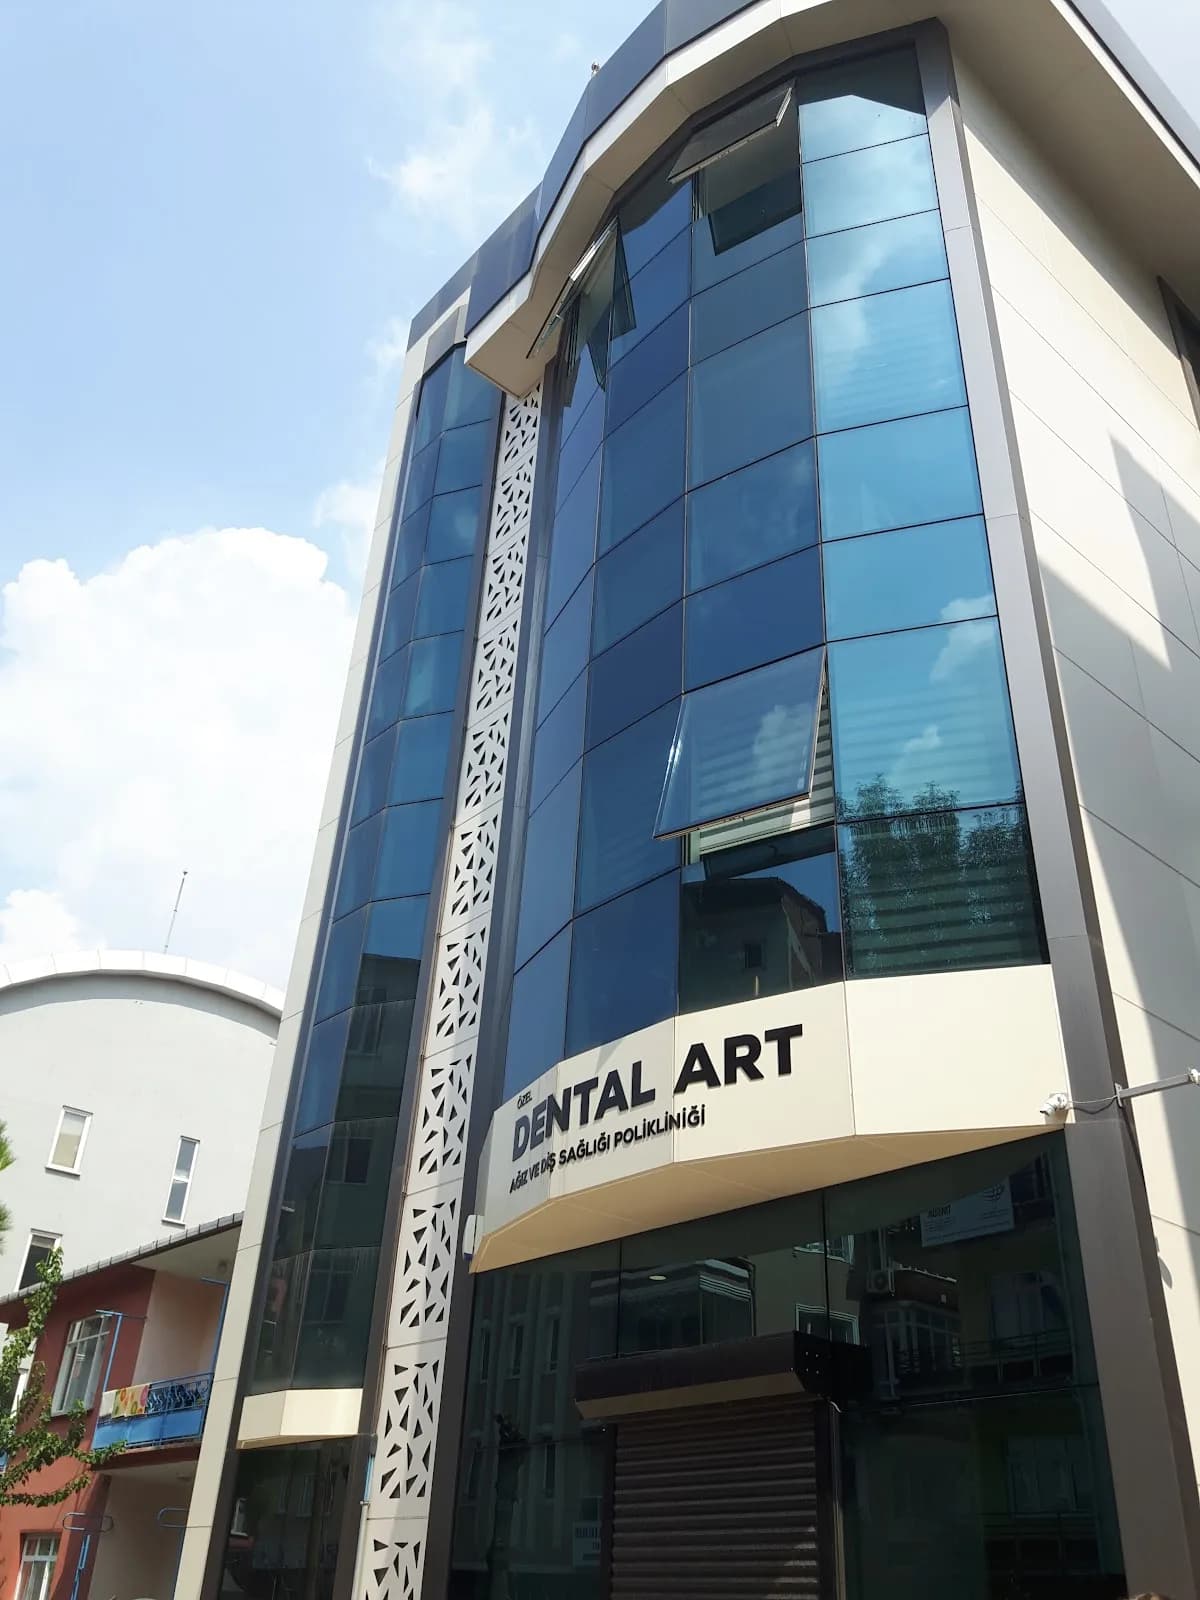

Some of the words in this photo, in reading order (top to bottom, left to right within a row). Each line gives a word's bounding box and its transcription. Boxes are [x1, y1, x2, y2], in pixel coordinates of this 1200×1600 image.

[512, 1060, 655, 1162] DENTAL
[673, 1024, 803, 1094] ART
[517, 1091, 532, 1109] ÖZEL
[509, 1169, 528, 1194] AĞIZ
[529, 1162, 540, 1181] VE
[541, 1151, 556, 1173] DİŞ
[559, 1131, 611, 1165] SAĞLIĞI
[614, 1104, 705, 1148] POLİKLİNİĞİ
